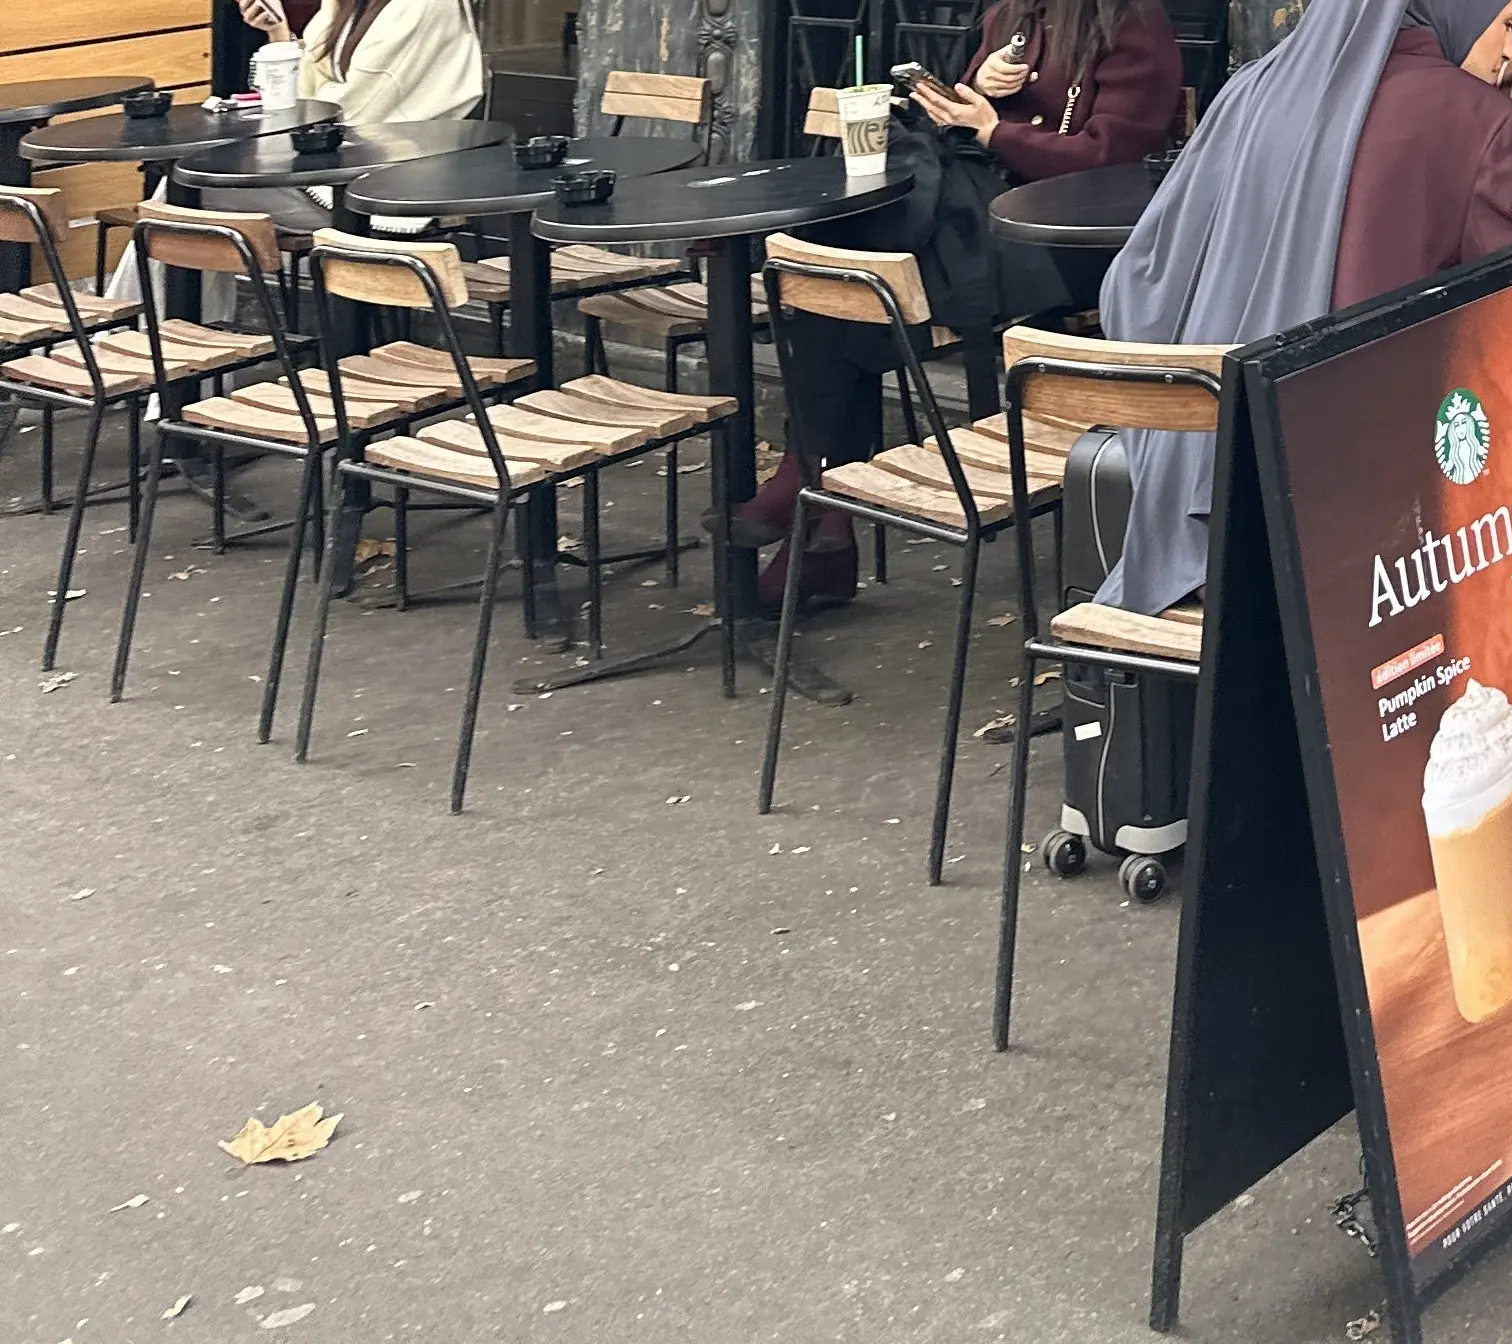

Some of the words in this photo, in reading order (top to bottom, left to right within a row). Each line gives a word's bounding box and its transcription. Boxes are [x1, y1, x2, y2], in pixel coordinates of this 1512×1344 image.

[1378, 674, 1436, 717] Pumpkin
[1435, 656, 1471, 685] Spice
[1381, 712, 1417, 742] Latte
